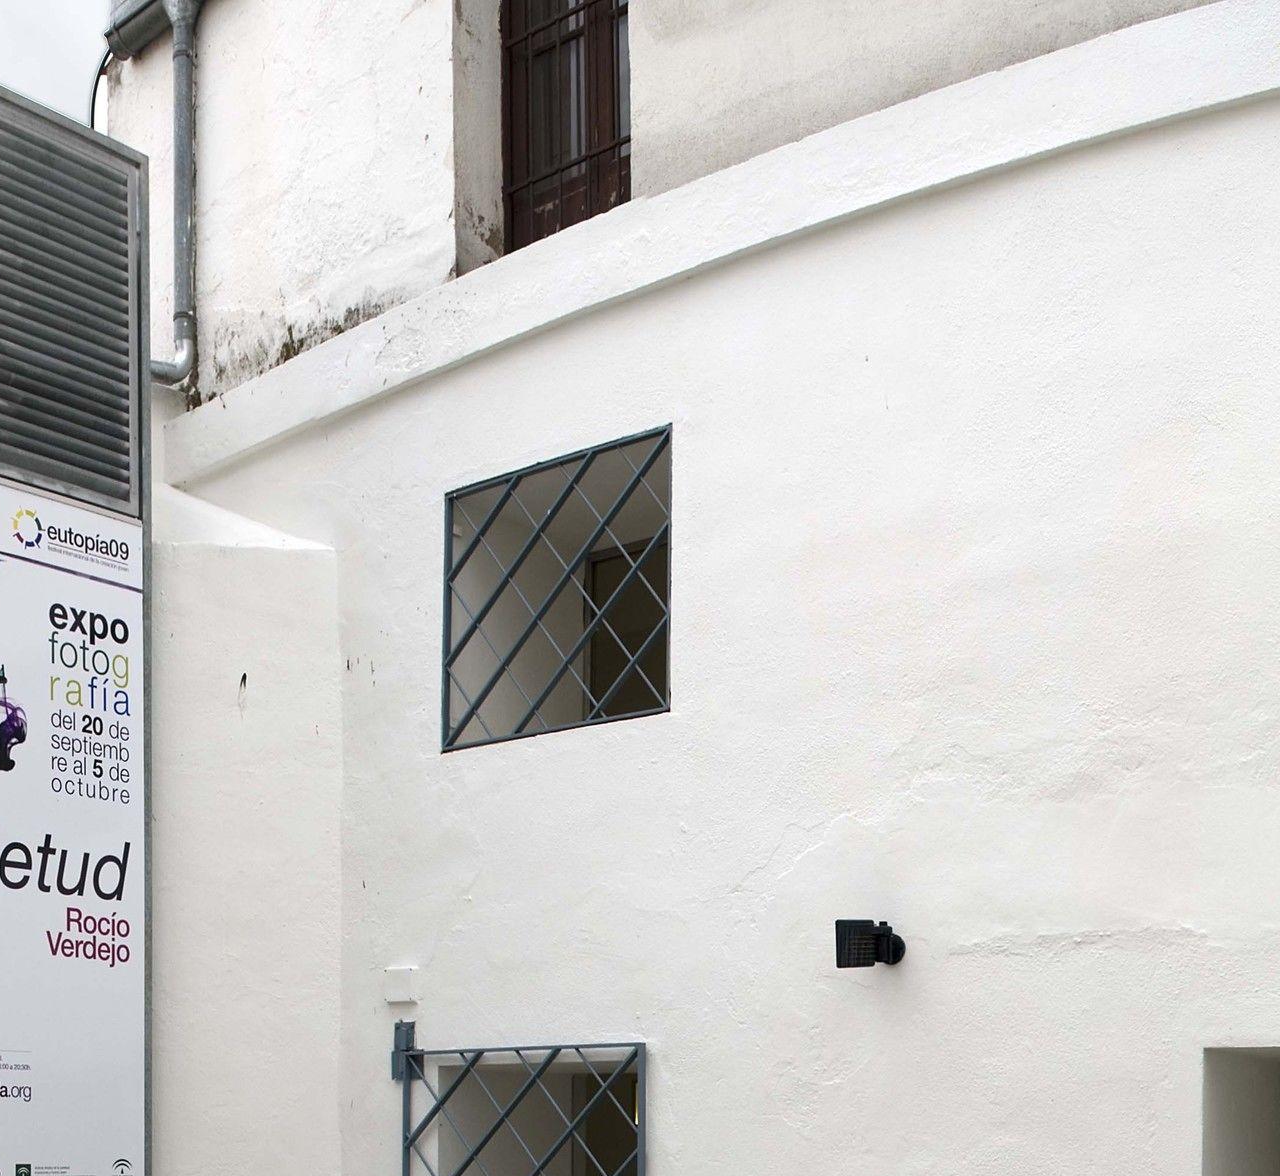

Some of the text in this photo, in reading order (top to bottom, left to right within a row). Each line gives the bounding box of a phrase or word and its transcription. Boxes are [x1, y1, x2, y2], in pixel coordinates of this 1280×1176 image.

[47, 525, 129, 560] eutopía09
[49, 603, 129, 644] expo
[48, 631, 129, 688] fotog
[50, 675, 130, 716] rafía
[51, 709, 129, 741] del 20 de
[51, 733, 130, 762] septiemb
[51, 754, 130, 783] re al 5 de
[51, 776, 131, 804] octubre
[66, 907, 130, 938] Rocío
[46, 930, 130, 968] Verdejo
